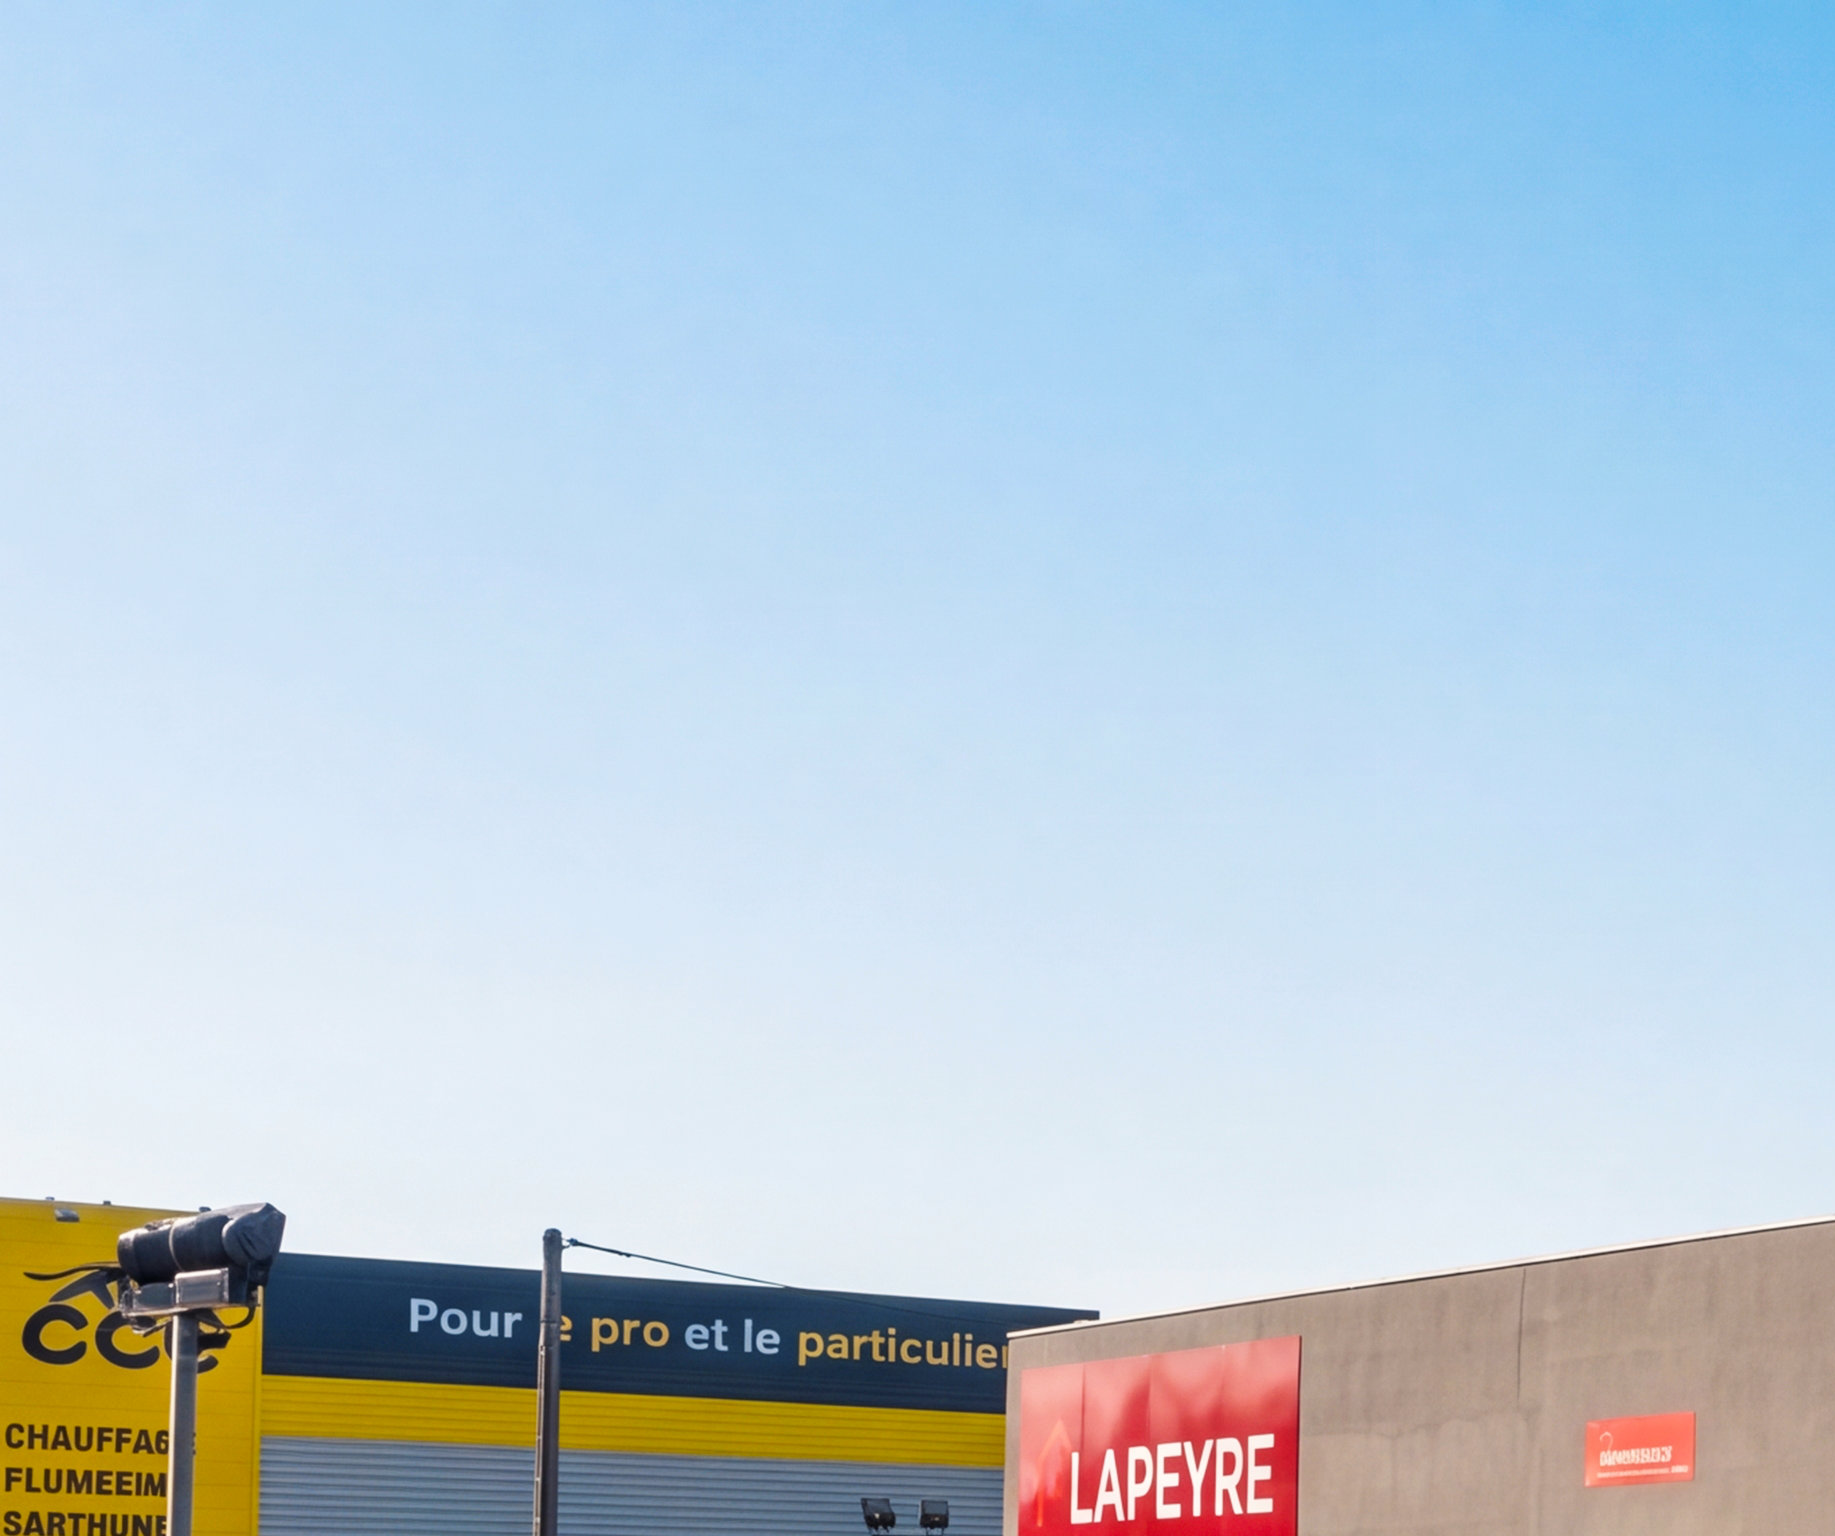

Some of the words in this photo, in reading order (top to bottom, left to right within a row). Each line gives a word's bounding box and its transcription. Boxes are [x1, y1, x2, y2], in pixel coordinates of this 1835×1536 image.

[410, 1298, 523, 1338] Pour
[591, 1317, 670, 1352] pro
[685, 1319, 728, 1351] et
[744, 1319, 780, 1354] le
[1070, 1433, 1275, 1525] LAPEYRE
